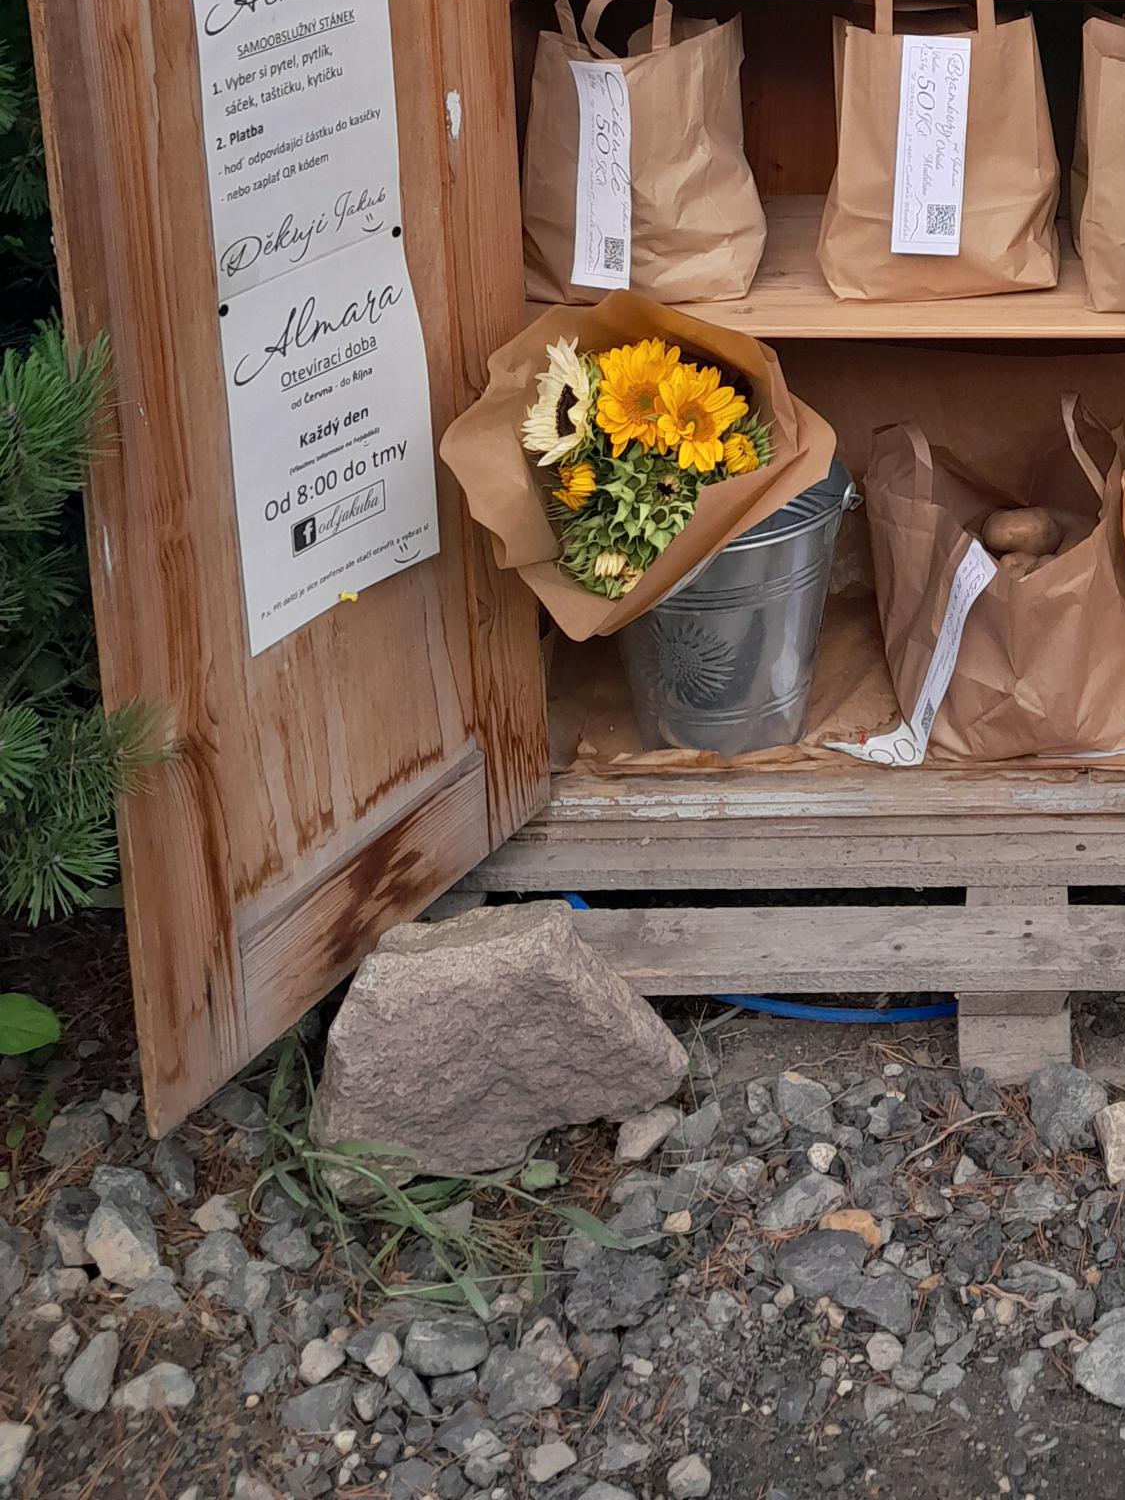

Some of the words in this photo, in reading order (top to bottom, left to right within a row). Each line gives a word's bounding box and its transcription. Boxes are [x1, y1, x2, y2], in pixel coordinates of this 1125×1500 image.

[237, 18, 317, 58] SAMOOBSLUŽNÝ
[319, 9, 355, 32] STÁNEK
[212, 82, 222, 95] 1.
[225, 71, 256, 91] Vyber
[259, 64, 268, 79] si
[270, 54, 299, 77] pytel,
[301, 44, 334, 67] pytlík,
[225, 95, 259, 116] sáček,
[260, 80, 305, 104] taštičku,
[306, 66, 343, 88] kytičku
[934, 52, 965, 144] Brambory
[215, 136, 226, 151] 2.
[229, 123, 264, 145] Platba
[247, 137, 304, 166] odpovídající
[305, 125, 334, 144] částku
[335, 120, 347, 132] do
[349, 108, 381, 128] kasičky
[595, 112, 611, 156] 50
[604, 71, 631, 197] Cibule
[226, 184, 251, 202] nebo
[252, 168, 281, 191] zaplať
[282, 164, 296, 180] QR
[298, 153, 329, 172] kódem
[219, 212, 328, 277] Děkuji
[333, 187, 386, 232] Jakub
[234, 285, 403, 387] Almara
[281, 346, 342, 389] Otevírací
[344, 334, 377, 360] doba
[291, 397, 302, 410] od
[304, 386, 333, 404] Června
[340, 377, 351, 388] do
[352, 367, 373, 382] Října
[299, 416, 340, 449] Každý
[343, 406, 369, 427] den
[264, 491, 291, 522] Od
[297, 469, 338, 506] 8:00
[343, 459, 367, 482] do
[371, 439, 408, 468] tmy
